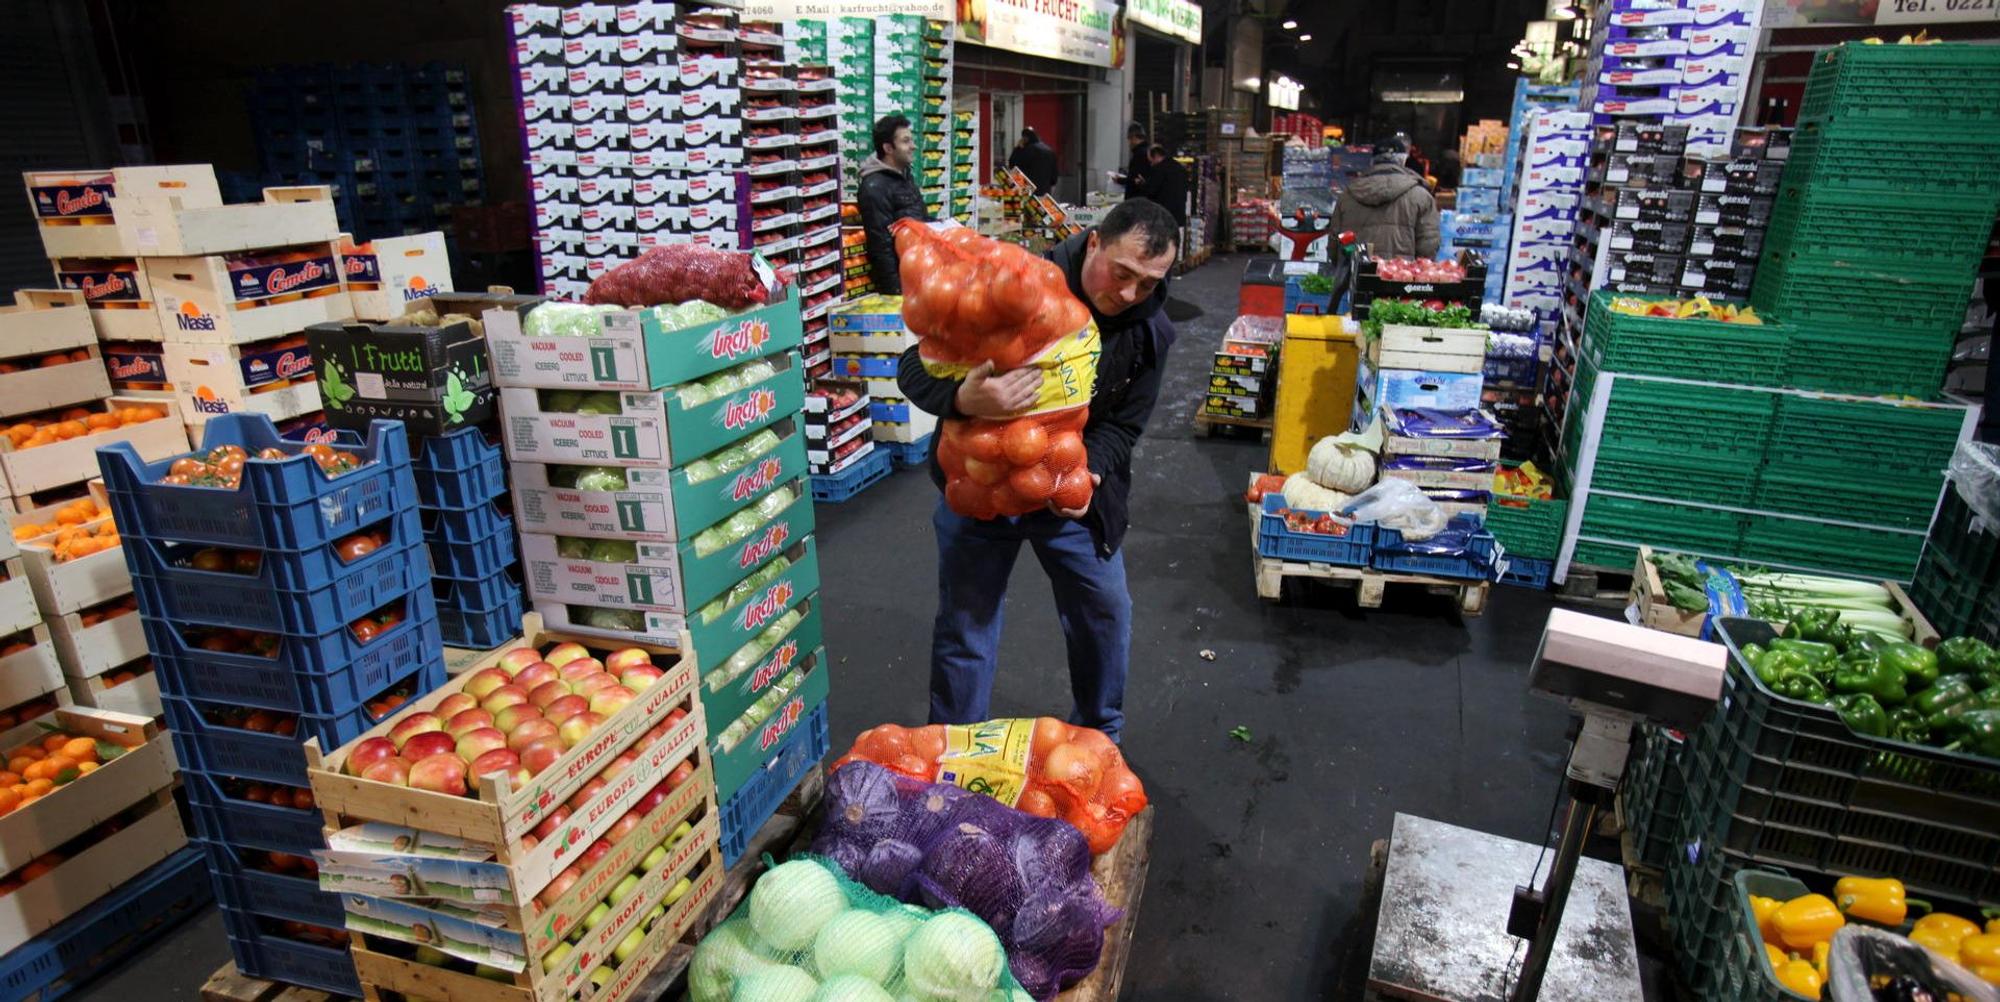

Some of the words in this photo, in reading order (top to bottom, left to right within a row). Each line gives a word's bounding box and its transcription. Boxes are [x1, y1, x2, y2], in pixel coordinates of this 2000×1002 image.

[806, 5, 829, 14] Mail
[266, 261, 323, 294] Cometa
[176, 313, 216, 331] Masiá
[363, 345, 424, 373] Frutti
[559, 352, 584, 361] COOLED
[192, 396, 229, 414] Masiá
[550, 419, 575, 428] VACUUM
[553, 438, 579, 448] ICEBERG
[579, 430, 604, 439] COOLED
[582, 449, 609, 459] LETTUCE
[567, 731, 618, 778] EUROPE
[645, 668, 691, 715] QUALITY
[588, 775, 636, 823] EUROPE
[651, 720, 696, 767] QUALITY
[579, 848, 630, 901] EUROPE
[651, 781, 700, 834] QUALITY
[599, 891, 646, 945] EUROPE
[661, 830, 706, 881] QUALITY
